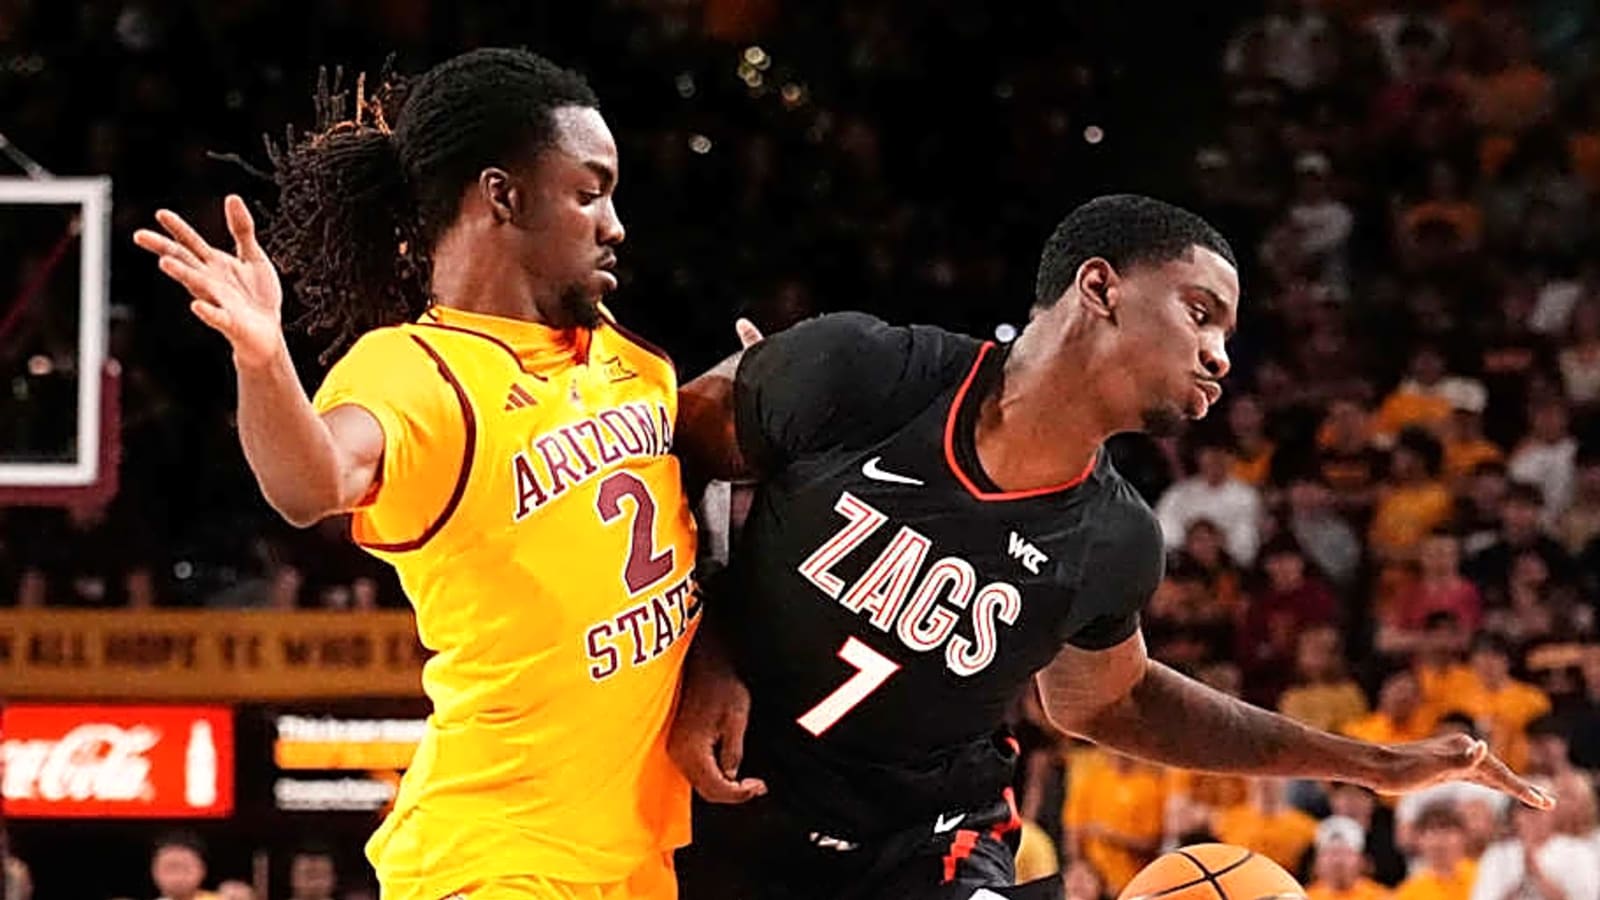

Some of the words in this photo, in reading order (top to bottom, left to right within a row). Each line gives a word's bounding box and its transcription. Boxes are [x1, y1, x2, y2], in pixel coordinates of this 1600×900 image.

[514, 401, 675, 519] ARIZONA
[596, 471, 674, 594] 2
[798, 491, 1021, 677] ZAGS
[796, 635, 901, 737] 7
